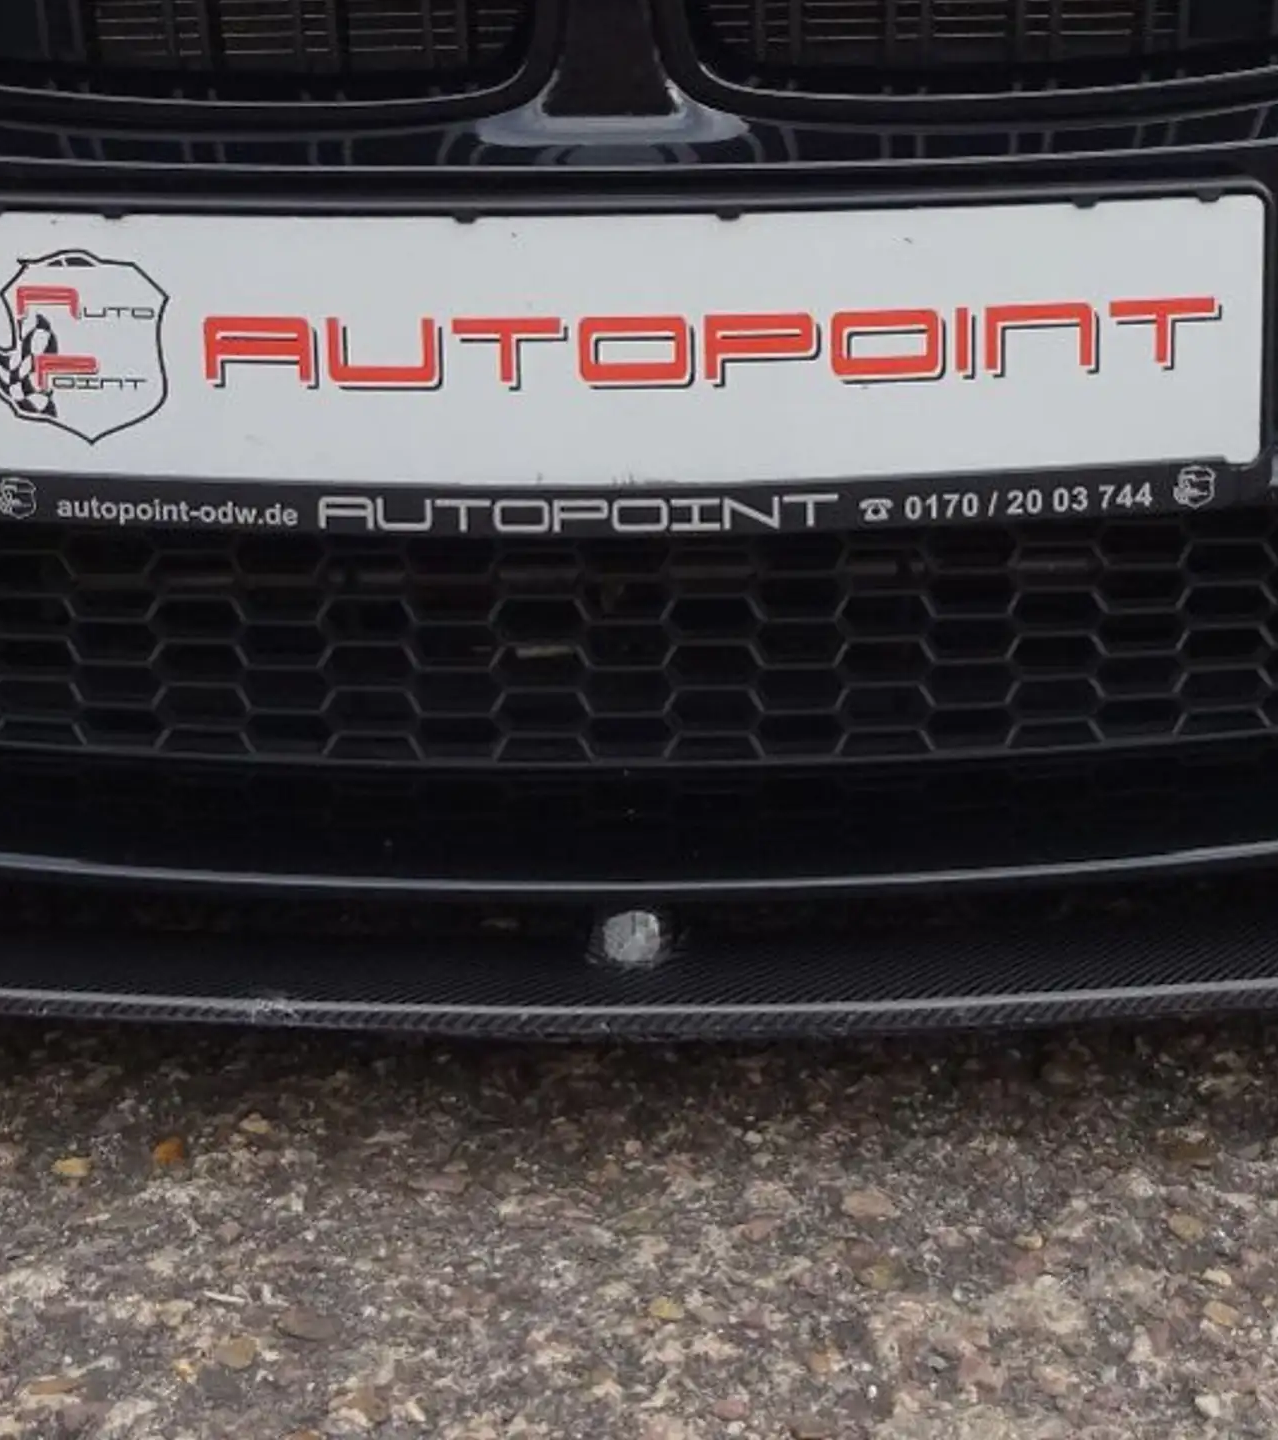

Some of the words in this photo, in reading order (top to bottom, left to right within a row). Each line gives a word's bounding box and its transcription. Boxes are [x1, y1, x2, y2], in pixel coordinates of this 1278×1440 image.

[203, 297, 1221, 390] AUTOPOINT
[56, 495, 298, 527] autopoint-odw.de
[317, 493, 839, 533] AUTOPOINT
[904, 492, 978, 520] 0170
[1006, 489, 1043, 516] 20
[1052, 486, 1089, 513] 03
[1098, 483, 1153, 510] 744
